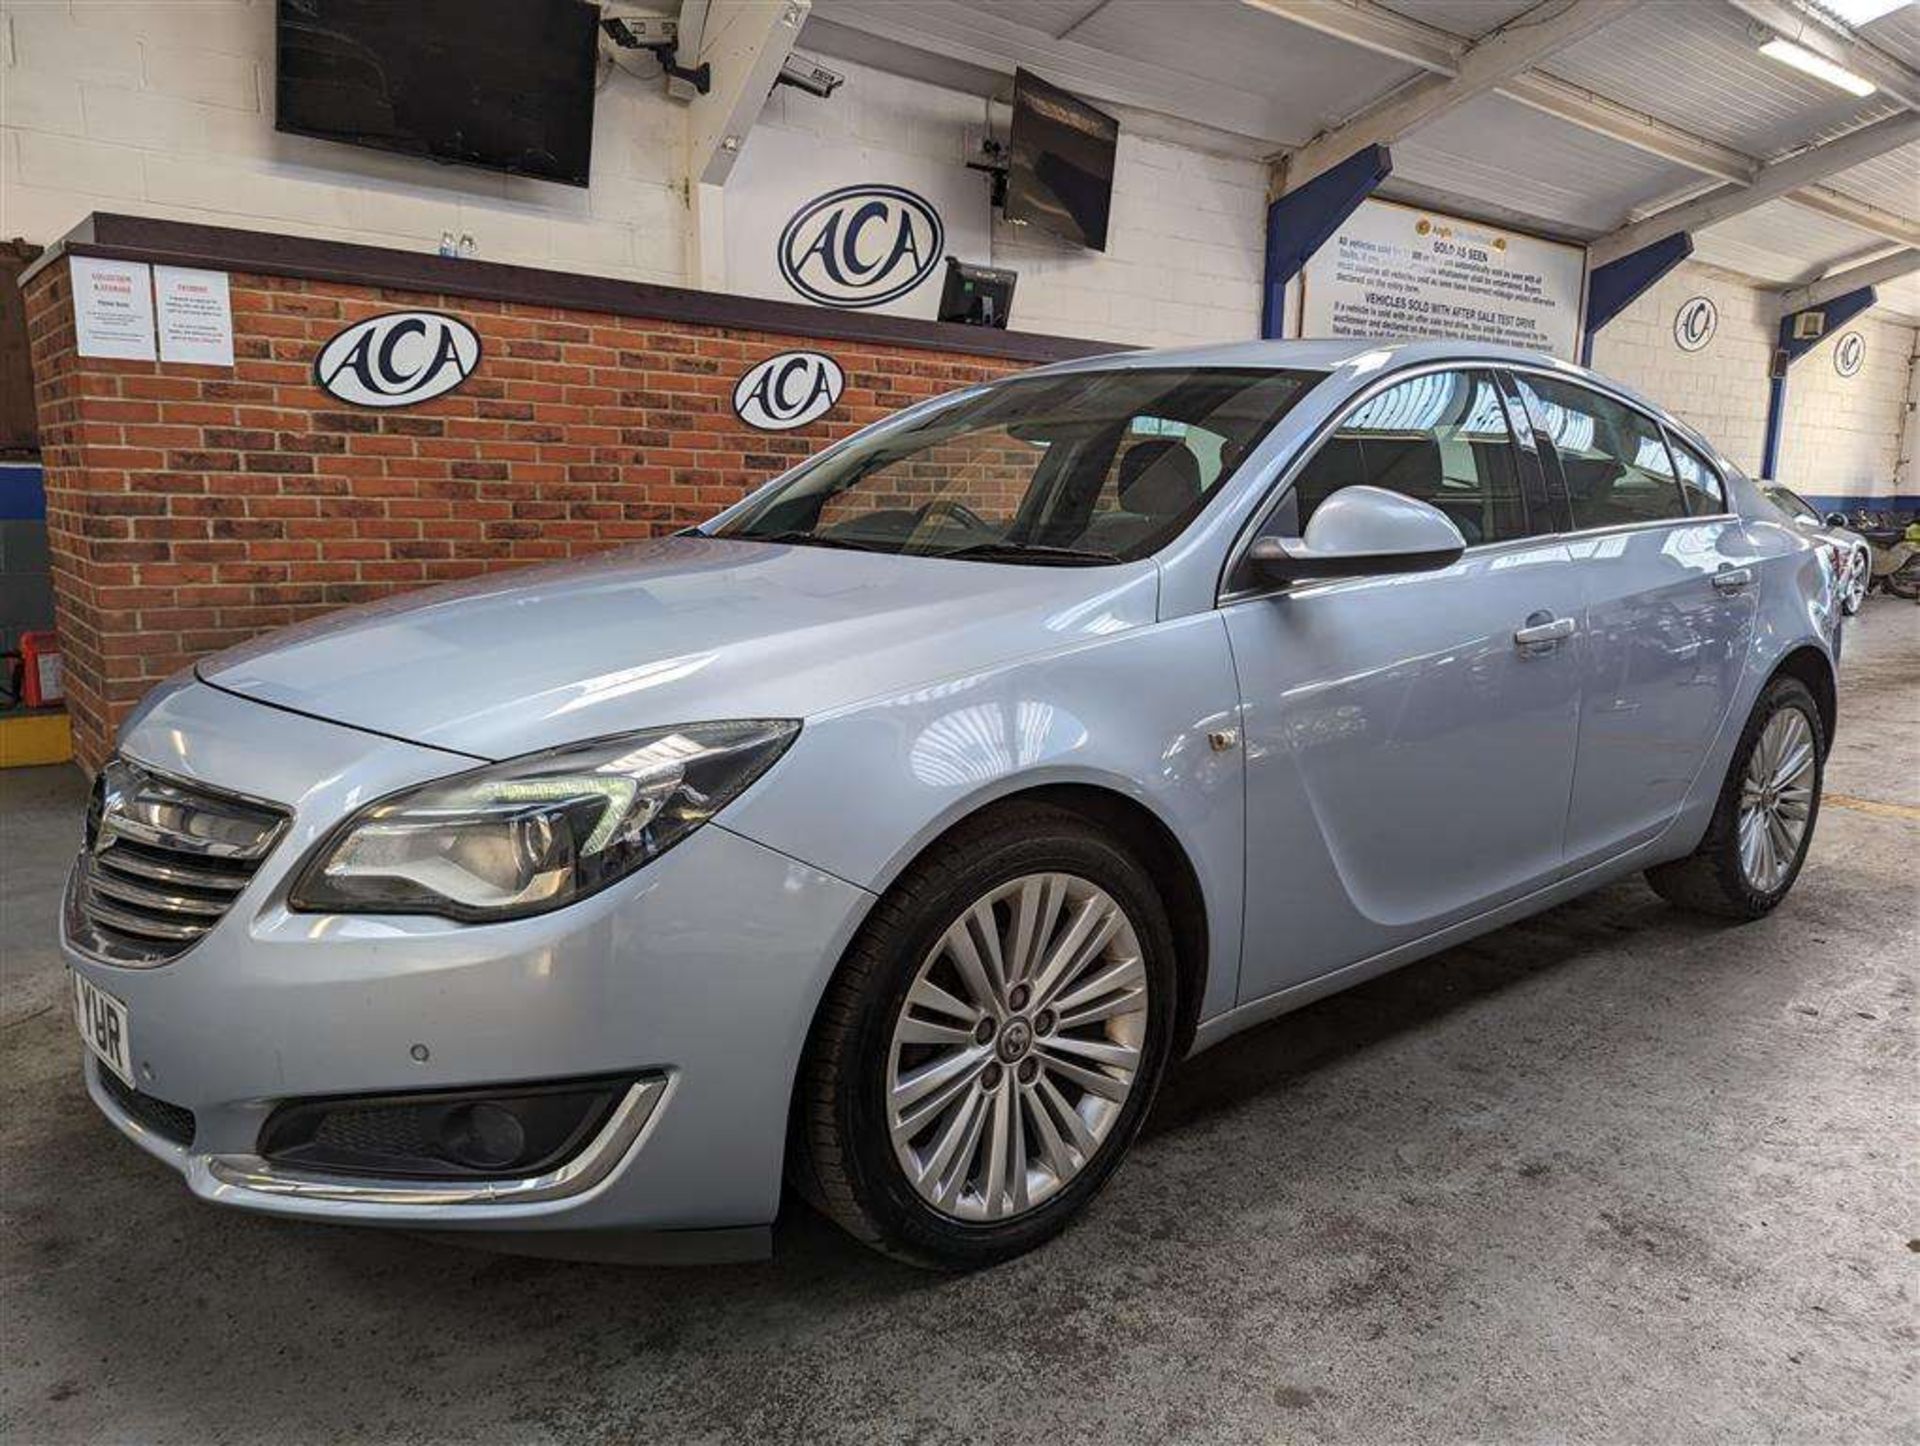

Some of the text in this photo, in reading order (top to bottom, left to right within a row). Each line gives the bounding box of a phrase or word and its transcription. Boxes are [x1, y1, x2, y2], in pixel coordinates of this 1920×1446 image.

[796, 201, 920, 287] ACA
[1433, 241, 1455, 255] SOLD
[1468, 248, 1488, 262] SEEN
[1365, 293, 1536, 329] VEHICLES SOLD WITH AFTER SALE TEST DRIVE
[1676, 303, 1711, 343] ACA
[325, 318, 465, 395] ACA
[739, 357, 833, 420] ACA
